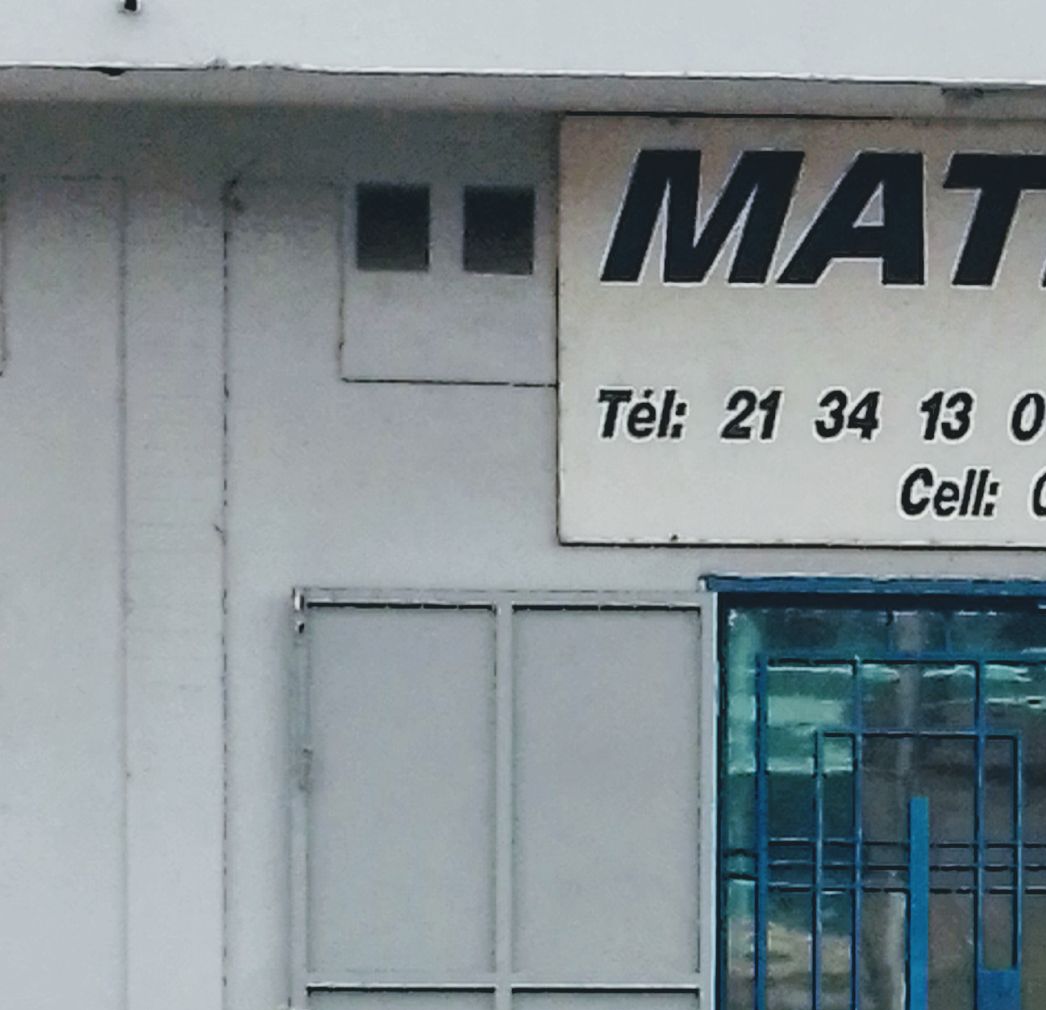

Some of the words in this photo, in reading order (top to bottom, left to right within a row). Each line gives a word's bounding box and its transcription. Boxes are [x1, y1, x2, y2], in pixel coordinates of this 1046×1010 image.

[720, 389, 782, 440] 21
[814, 390, 881, 441] 34
[920, 391, 974, 441] 13
[900, 467, 1000, 517] Cell:
